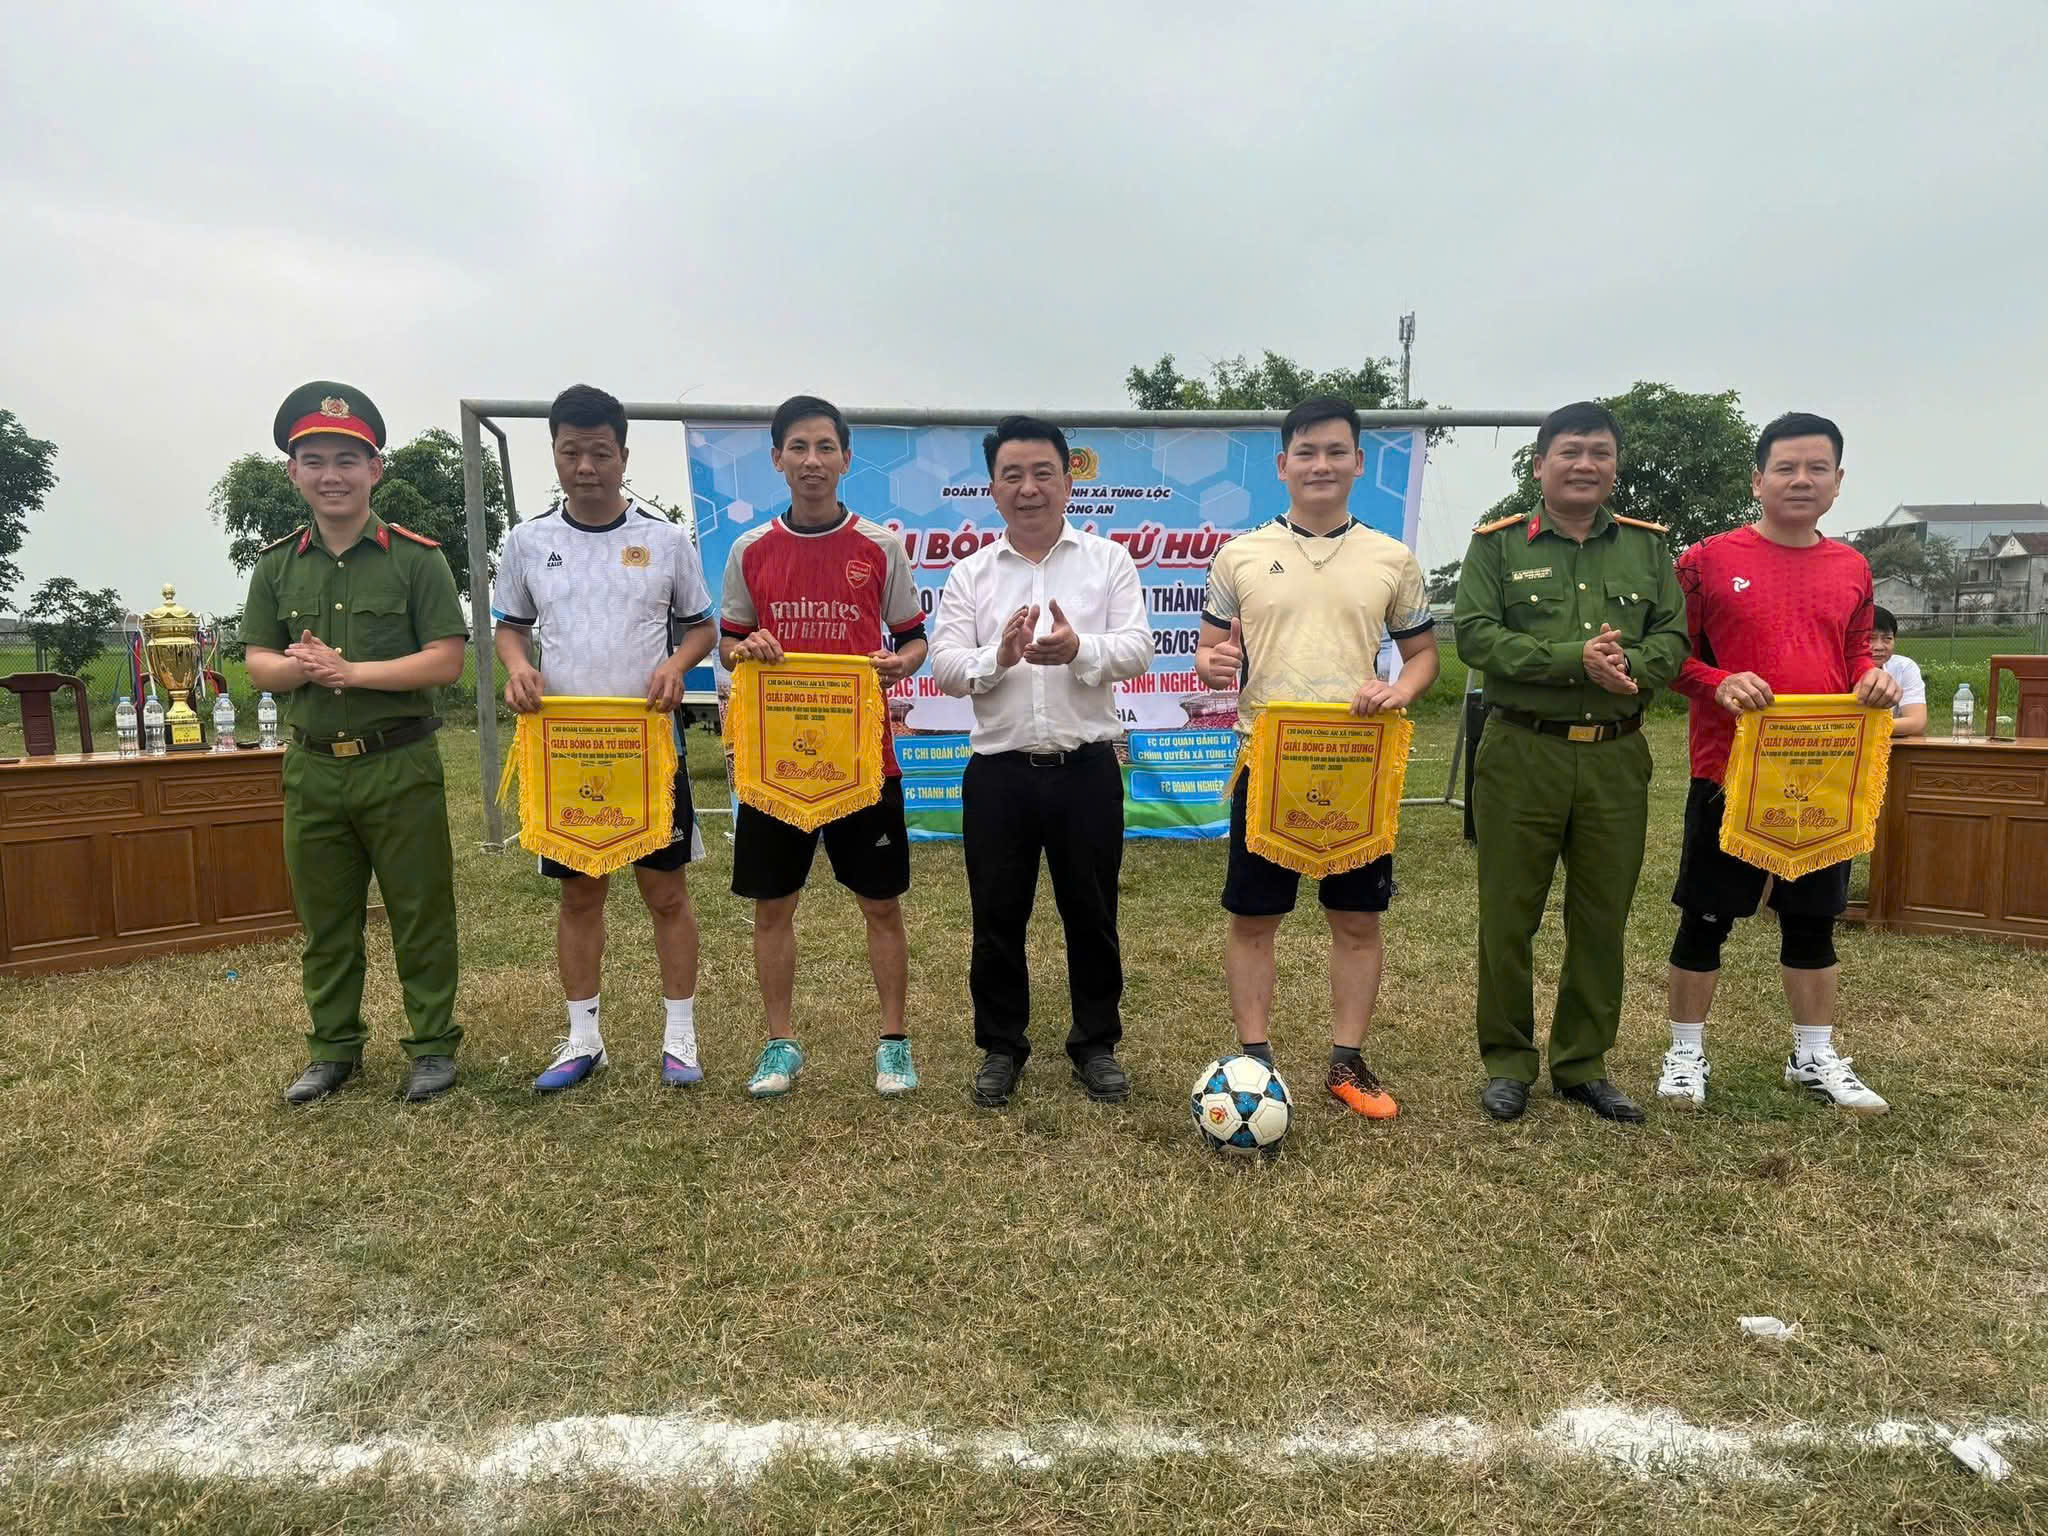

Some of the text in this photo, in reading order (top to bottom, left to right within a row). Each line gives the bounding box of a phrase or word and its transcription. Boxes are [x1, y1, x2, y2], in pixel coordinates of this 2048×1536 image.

[942, 485, 978, 497] ĐOÀN
[1090, 487, 1107, 498] XÃ
[1110, 486, 1144, 498] TÙNG
[1146, 487, 1171, 501] LỘC
[1095, 505, 1114, 514] AN
[777, 622, 798, 640] FLY
[1122, 672, 1156, 694] SINH
[902, 747, 912, 760] FC
[914, 747, 928, 760] CHI
[954, 744, 974, 759] CÔN
[905, 787, 916, 800] FC
[918, 786, 944, 799] THANH
